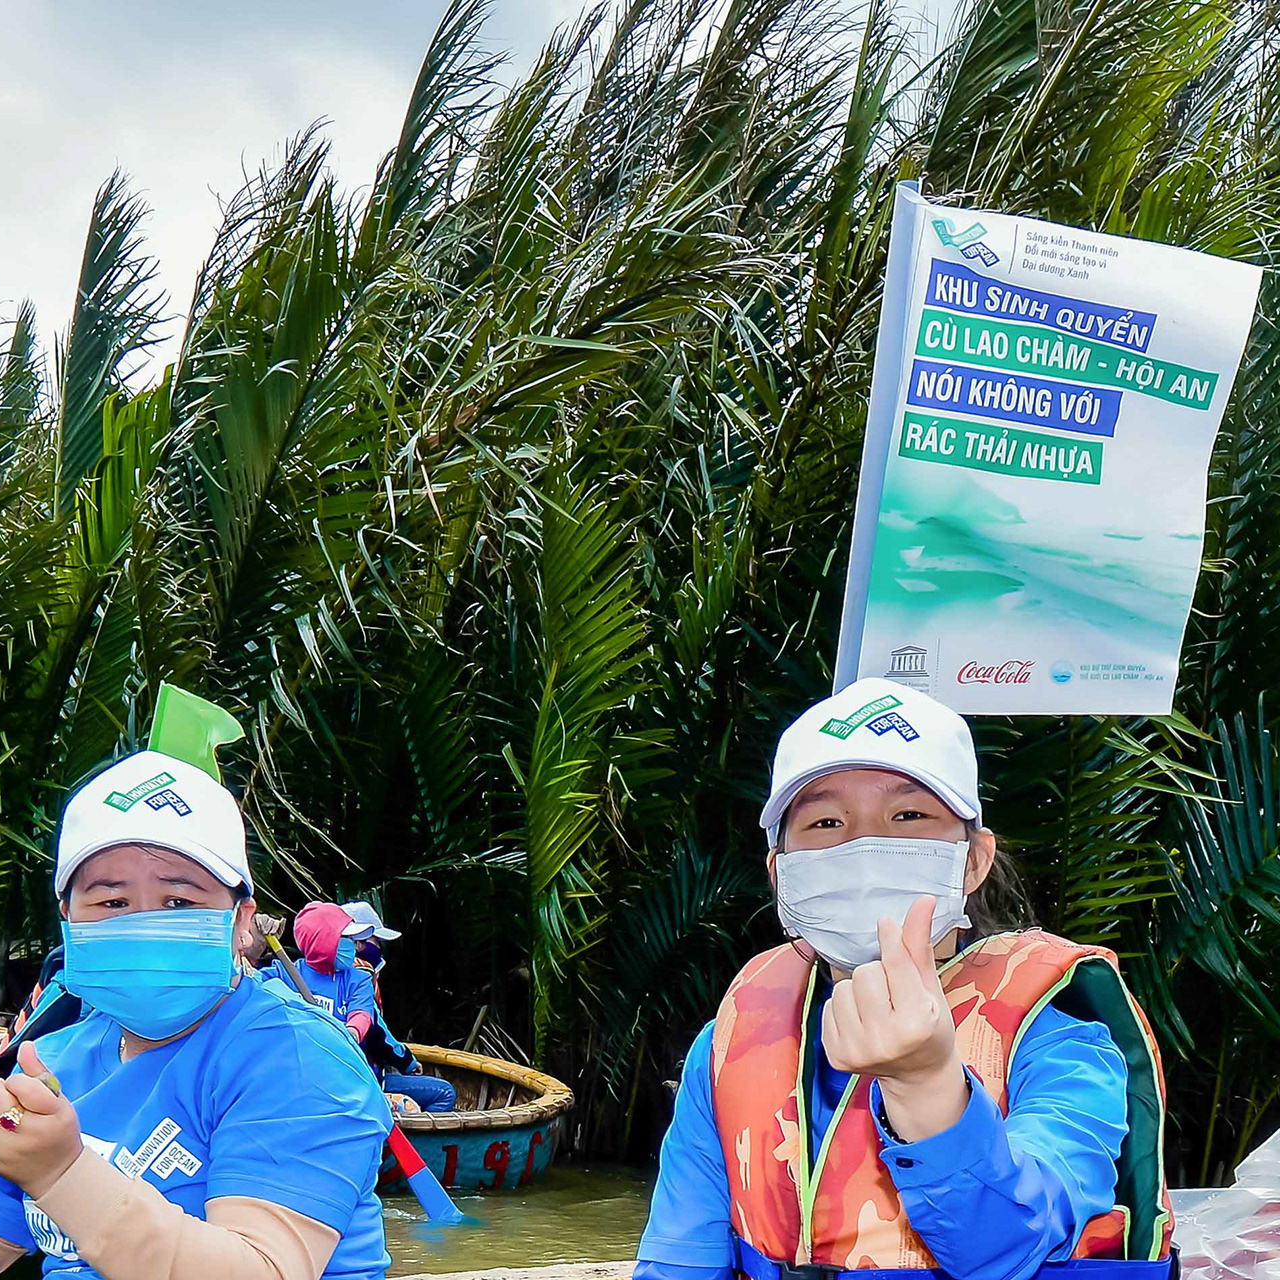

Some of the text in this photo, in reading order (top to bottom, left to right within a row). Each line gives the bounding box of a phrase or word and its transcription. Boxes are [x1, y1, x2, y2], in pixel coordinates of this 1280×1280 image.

[1026, 232, 1048, 245] Sáng
[1071, 238, 1098, 253] Thanh
[1099, 245, 1119, 258] niên
[1040, 246, 1058, 258] mới
[1059, 250, 1080, 266] sáng
[1082, 254, 1097, 268] tạo
[1022, 258, 1090, 280] Đại dương Xanh
[935, 273, 1149, 348] KHU SINH QUYỂN
[924, 316, 957, 351] CÙ
[963, 327, 1009, 360] LAO
[1016, 334, 1092, 372] CHÀM
[1115, 358, 1165, 390] HỘI
[1168, 373, 1210, 402] AN
[916, 368, 1102, 426] NÓI KHÔNG VỚI
[904, 420, 1094, 478] RÁC THẢI NHỰA
[871, 717, 893, 733] FOR
[888, 713, 917, 740] OCEAN
[136, 1121, 177, 1168] INNOVATION
[120, 1152, 140, 1176] YOUTH
[156, 1156, 173, 1174] FOR
[168, 1146, 197, 1172] OCEAN
